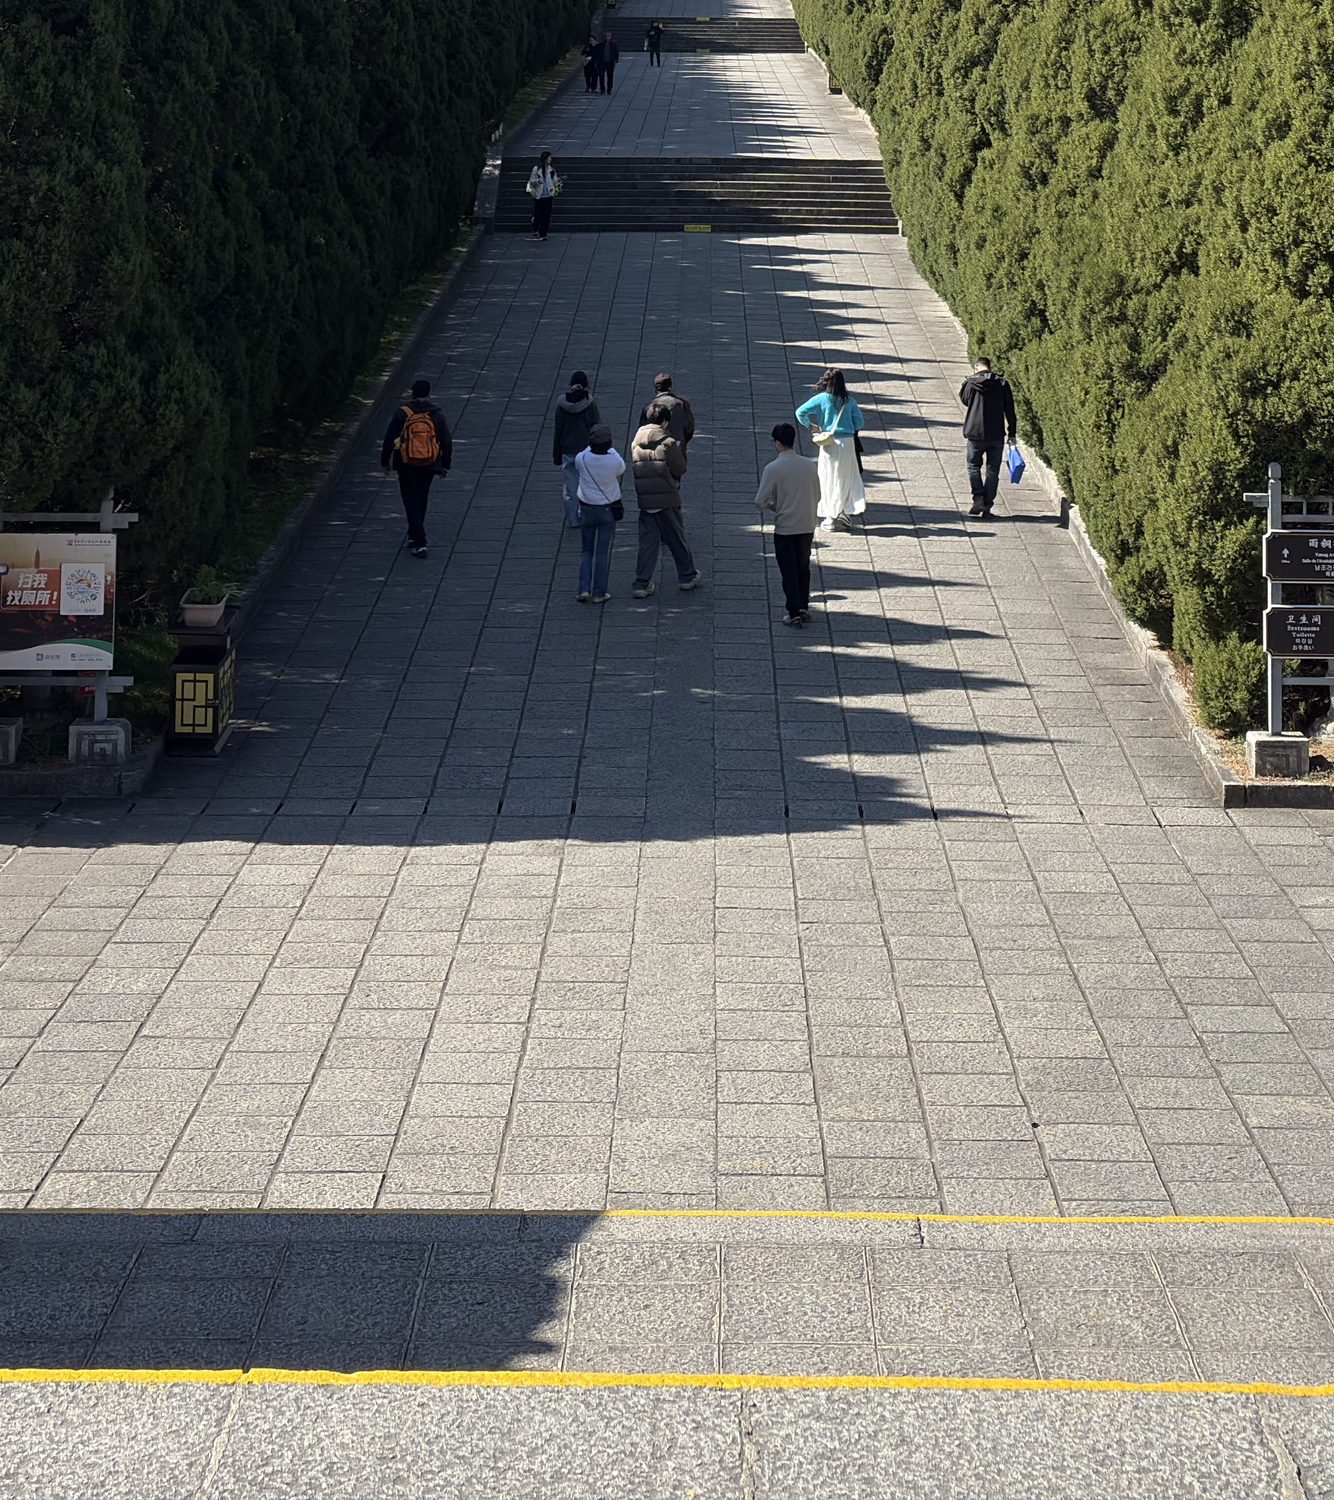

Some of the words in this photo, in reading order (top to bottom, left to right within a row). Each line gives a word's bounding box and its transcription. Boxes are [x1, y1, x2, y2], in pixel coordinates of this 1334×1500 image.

[18, 573, 48, 588] 扫我
[1286, 614, 1321, 625] 卫生间
